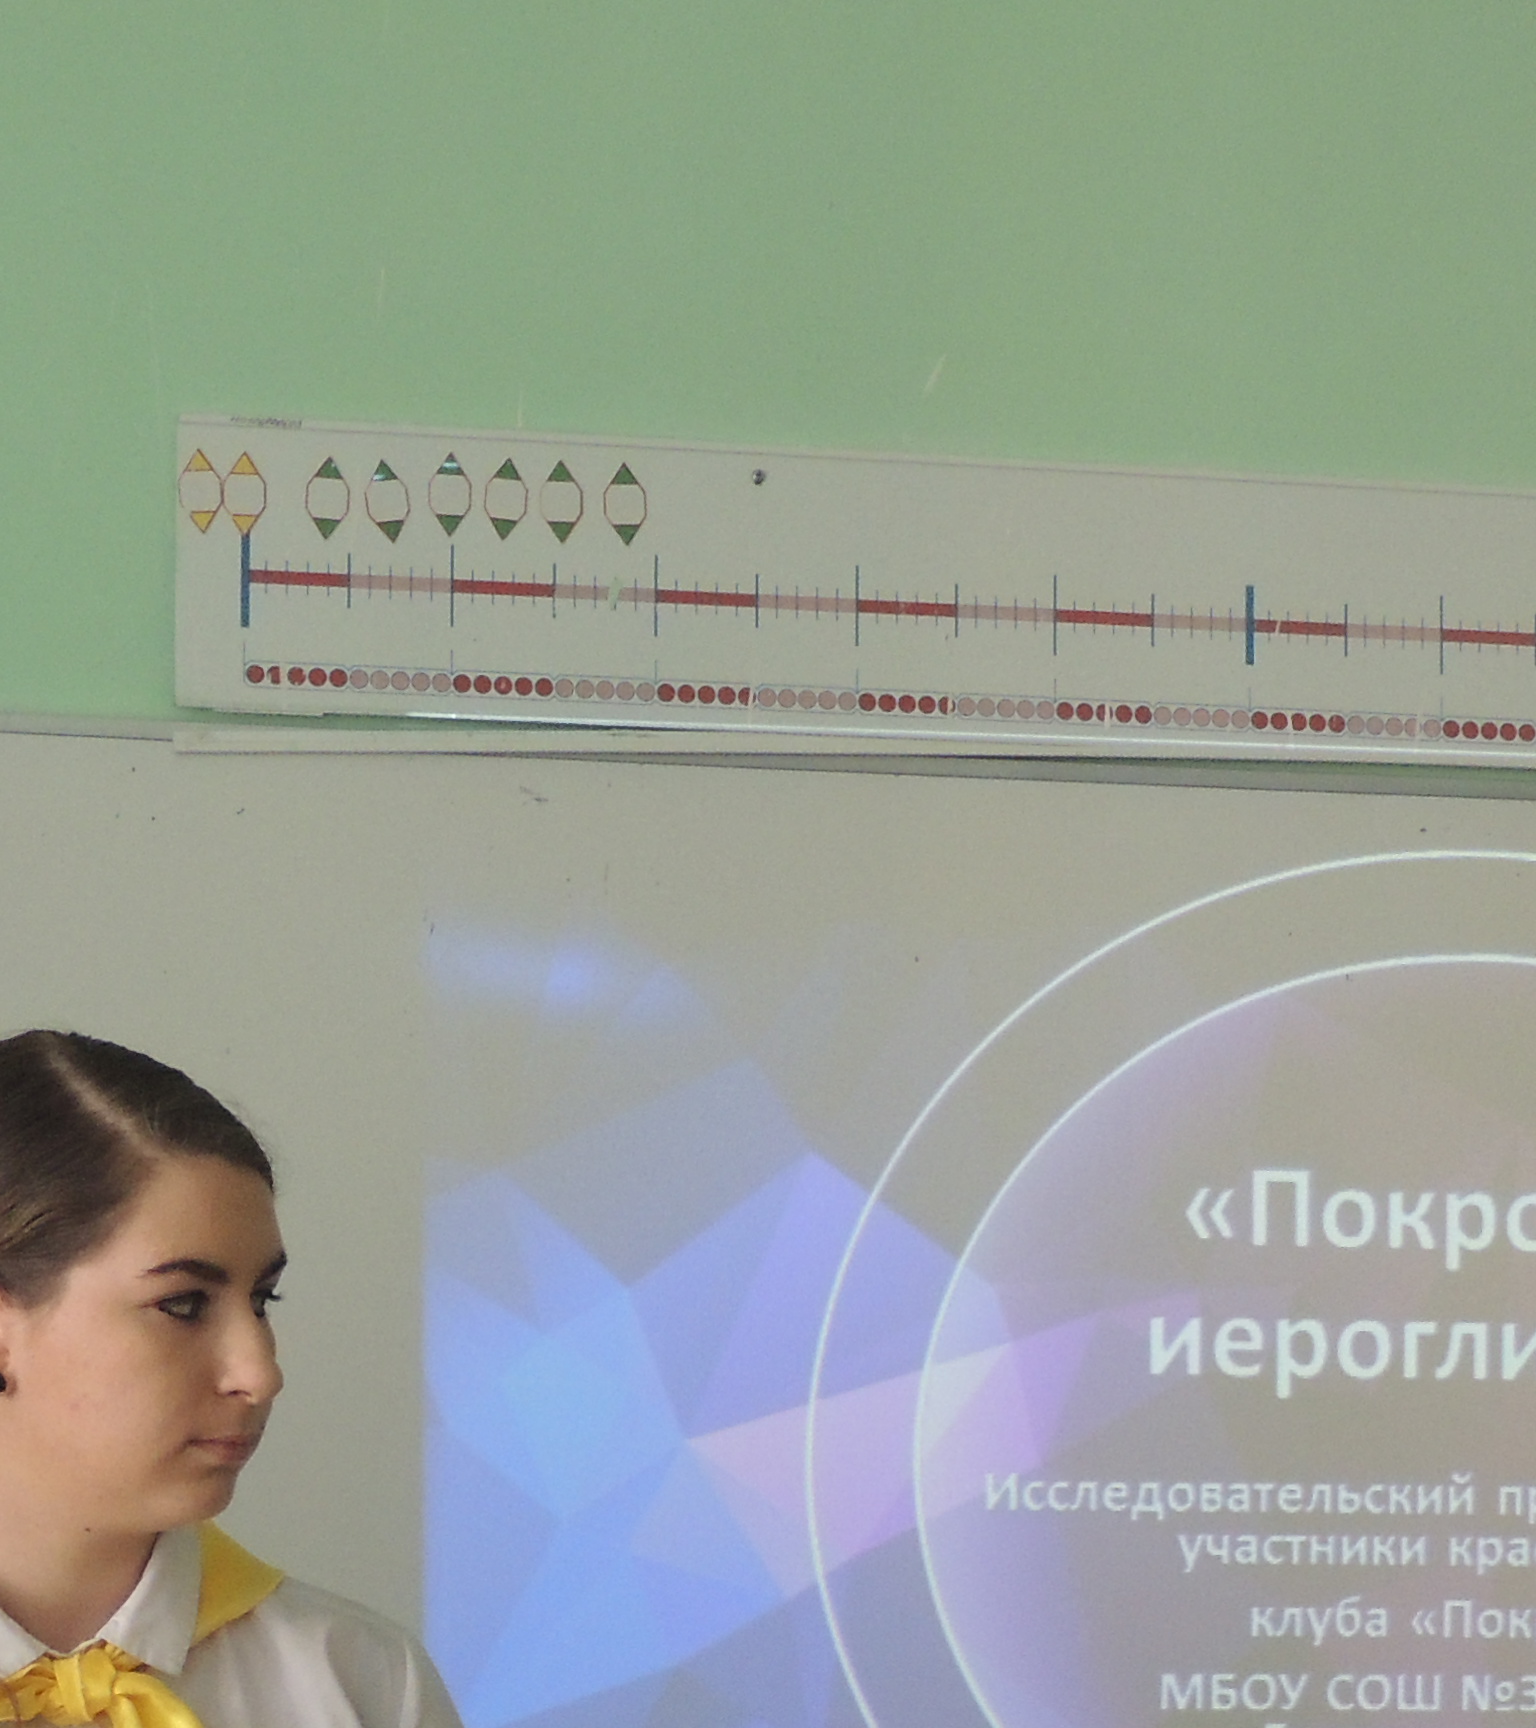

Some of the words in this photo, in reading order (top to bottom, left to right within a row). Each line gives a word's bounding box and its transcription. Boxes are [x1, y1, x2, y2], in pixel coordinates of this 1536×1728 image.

[984, 1471, 1475, 1521] Исследовательский
[1178, 1532, 1427, 1573] участники
[1250, 1596, 1389, 1646] клуба
[1159, 1672, 1308, 1711] МБОУ
[1326, 1673, 1442, 1712] СОШ
